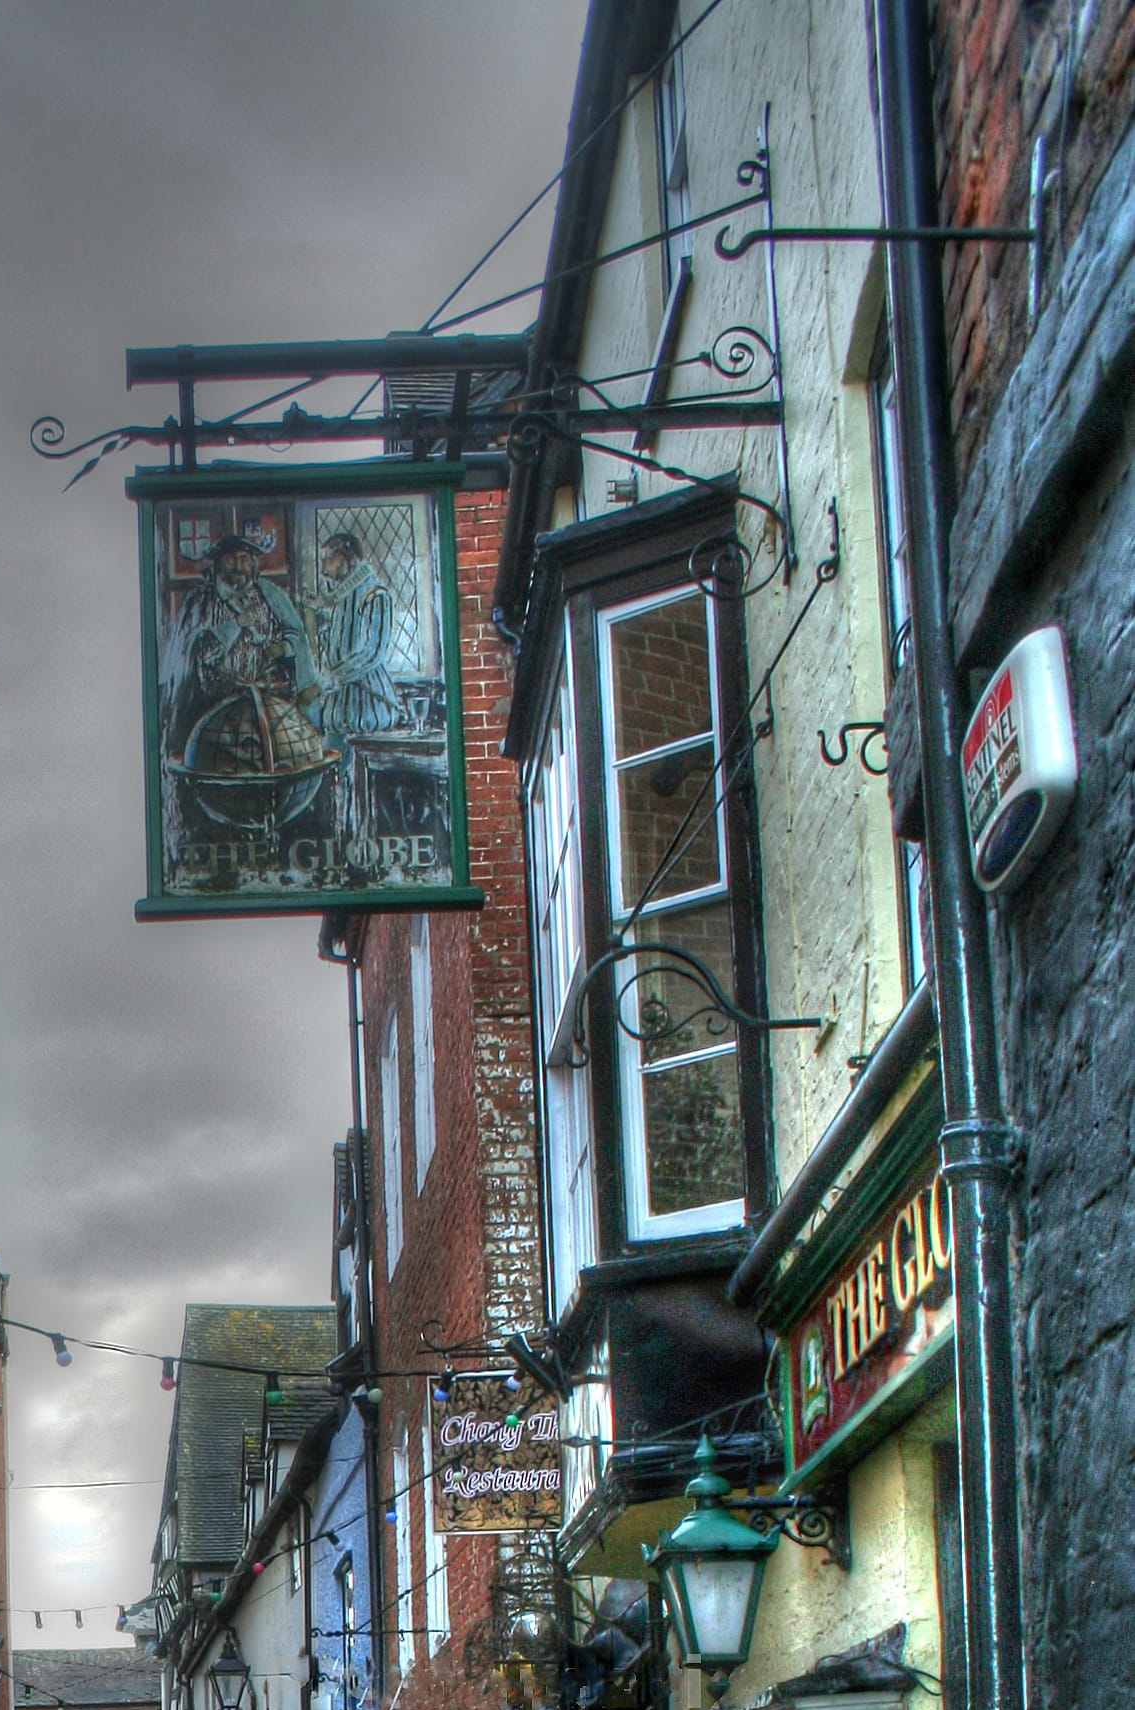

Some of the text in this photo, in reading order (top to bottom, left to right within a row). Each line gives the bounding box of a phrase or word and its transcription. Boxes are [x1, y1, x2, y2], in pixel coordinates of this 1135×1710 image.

[180, 834, 437, 874] THE GLOBE
[827, 1240, 887, 1382] THE
[441, 1412, 525, 1451] Chang
